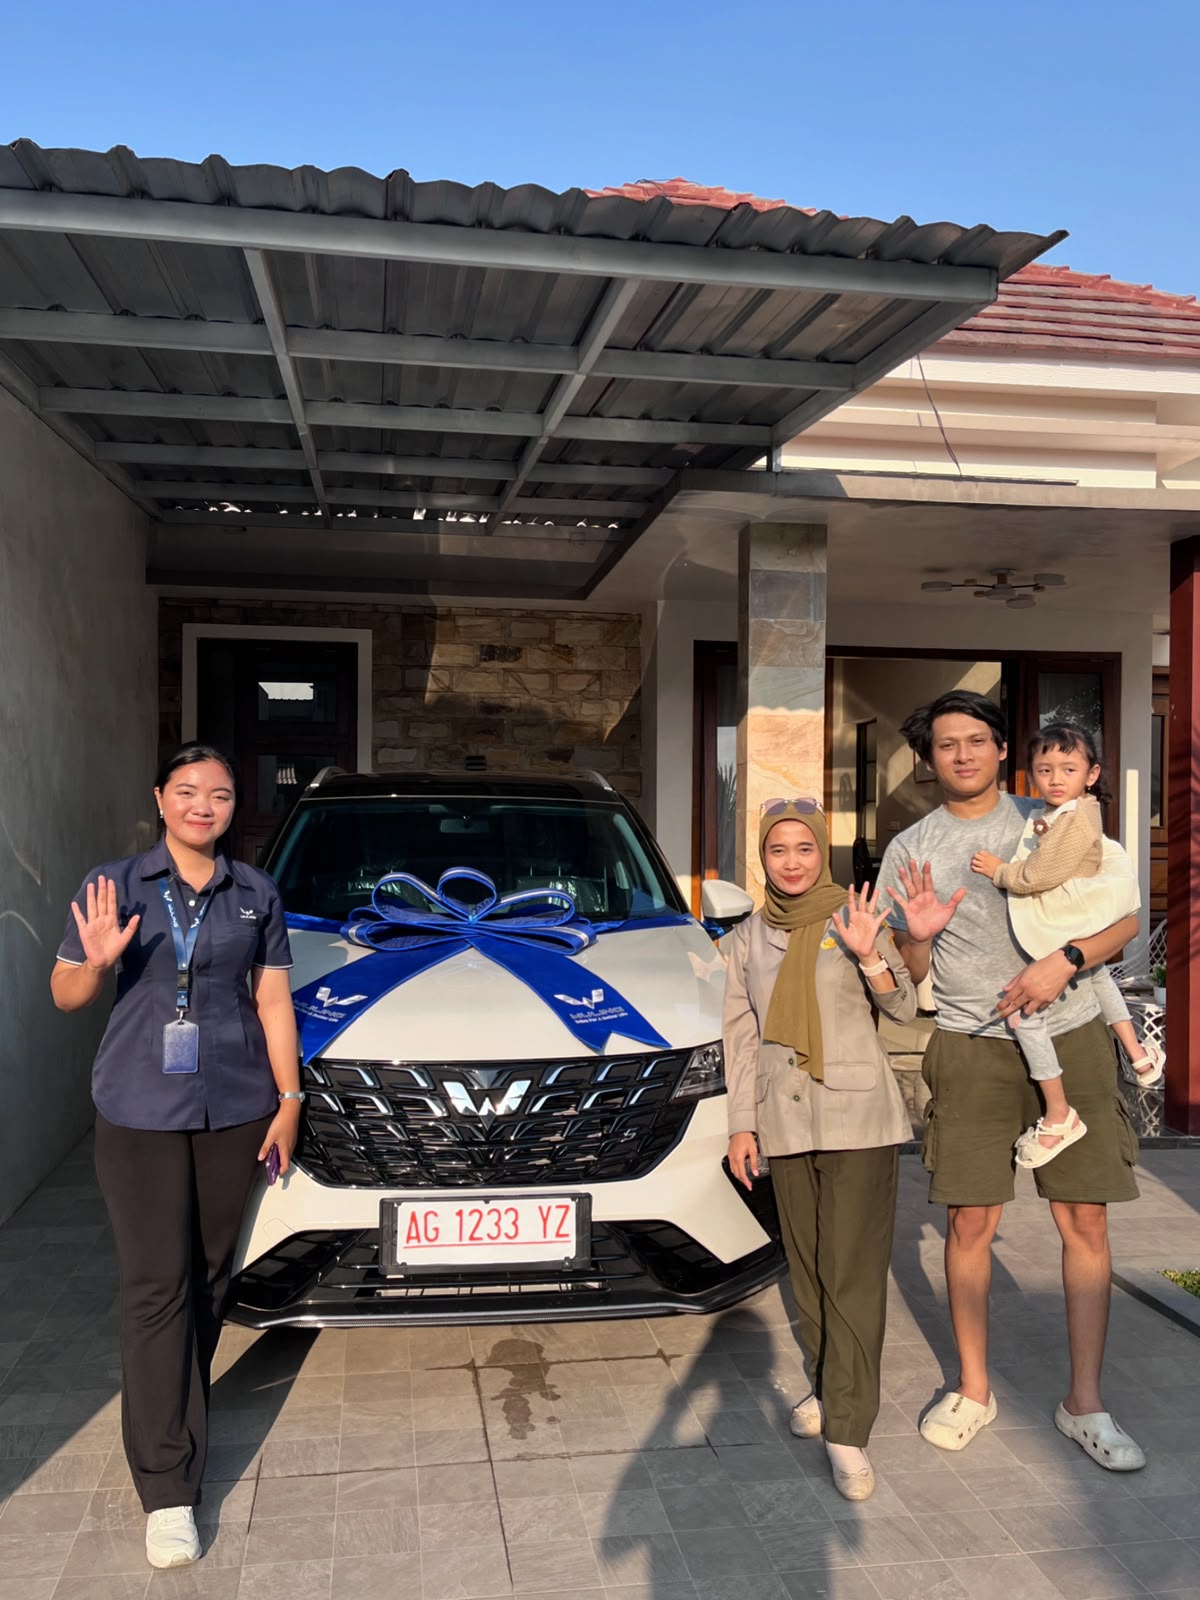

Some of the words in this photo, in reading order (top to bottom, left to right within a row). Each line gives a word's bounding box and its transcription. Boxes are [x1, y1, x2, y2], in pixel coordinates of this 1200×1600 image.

[405, 1211, 440, 1245] AG
[455, 1207, 520, 1242] 1233
[538, 1204, 571, 1239] YZ
